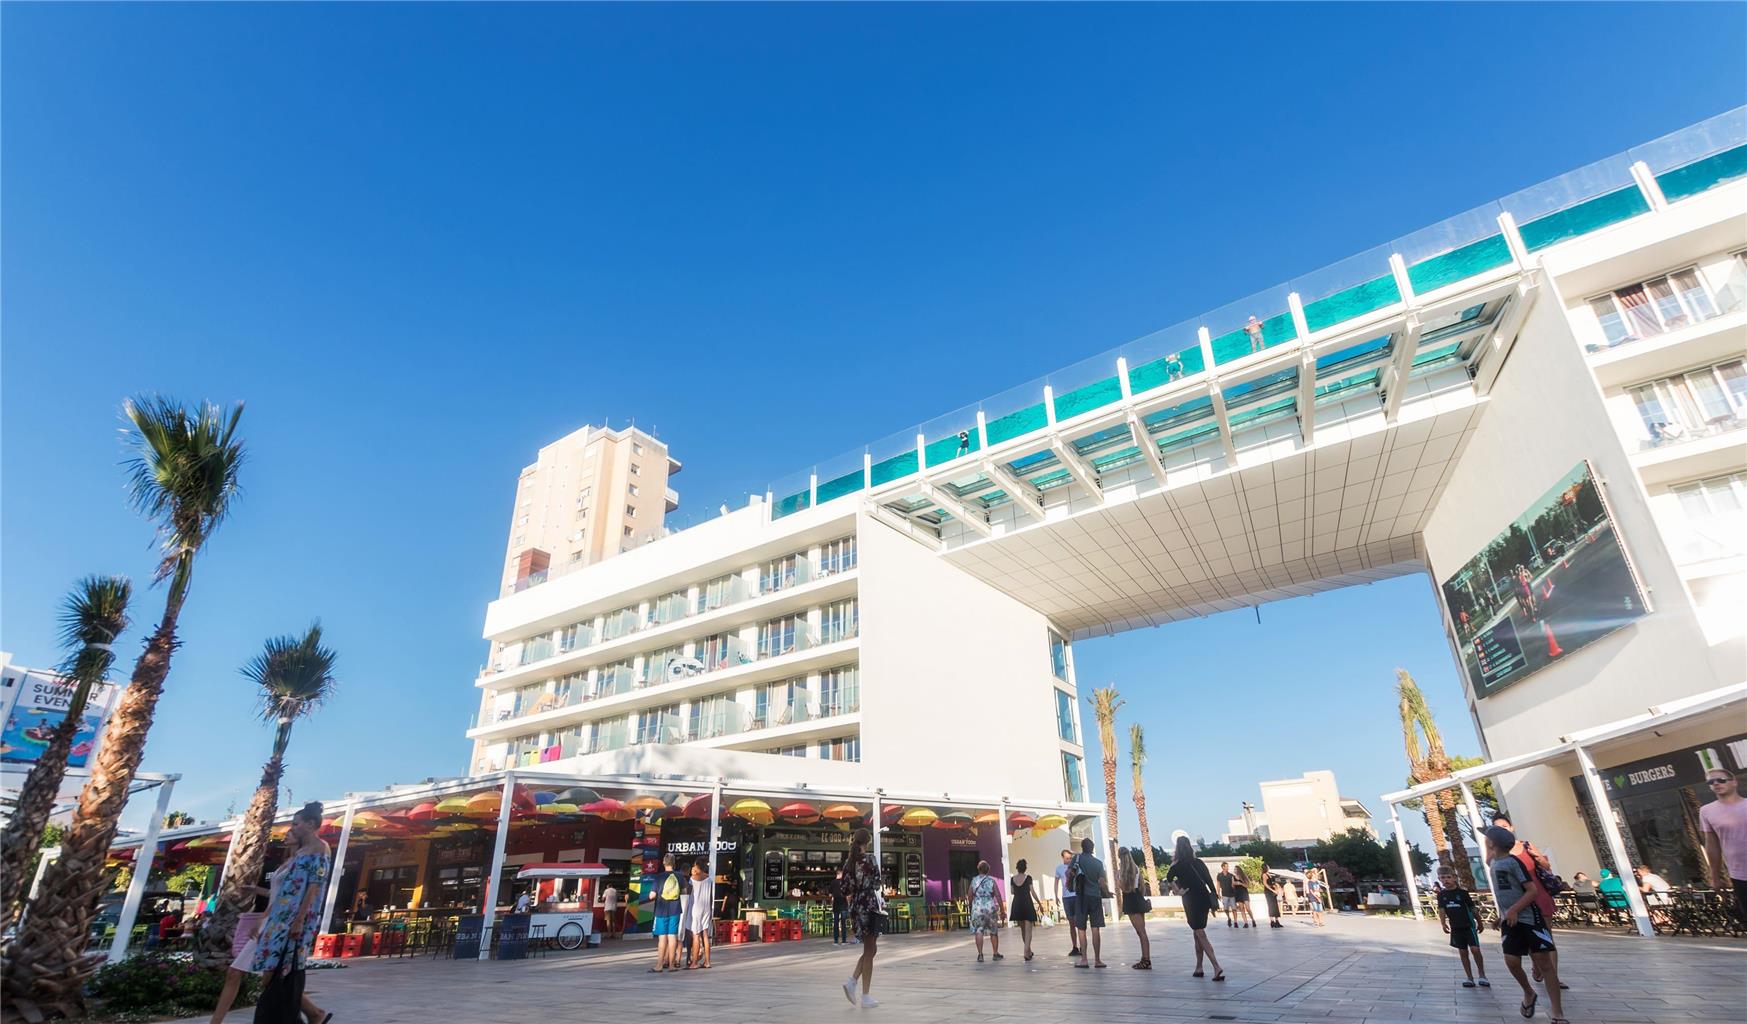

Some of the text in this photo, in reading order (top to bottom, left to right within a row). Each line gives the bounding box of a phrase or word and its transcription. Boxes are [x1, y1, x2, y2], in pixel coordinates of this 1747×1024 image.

[33, 694, 91, 711] EVENS
[1628, 764, 1676, 786] BURGERS
[667, 841, 737, 853] URBAN OOD
